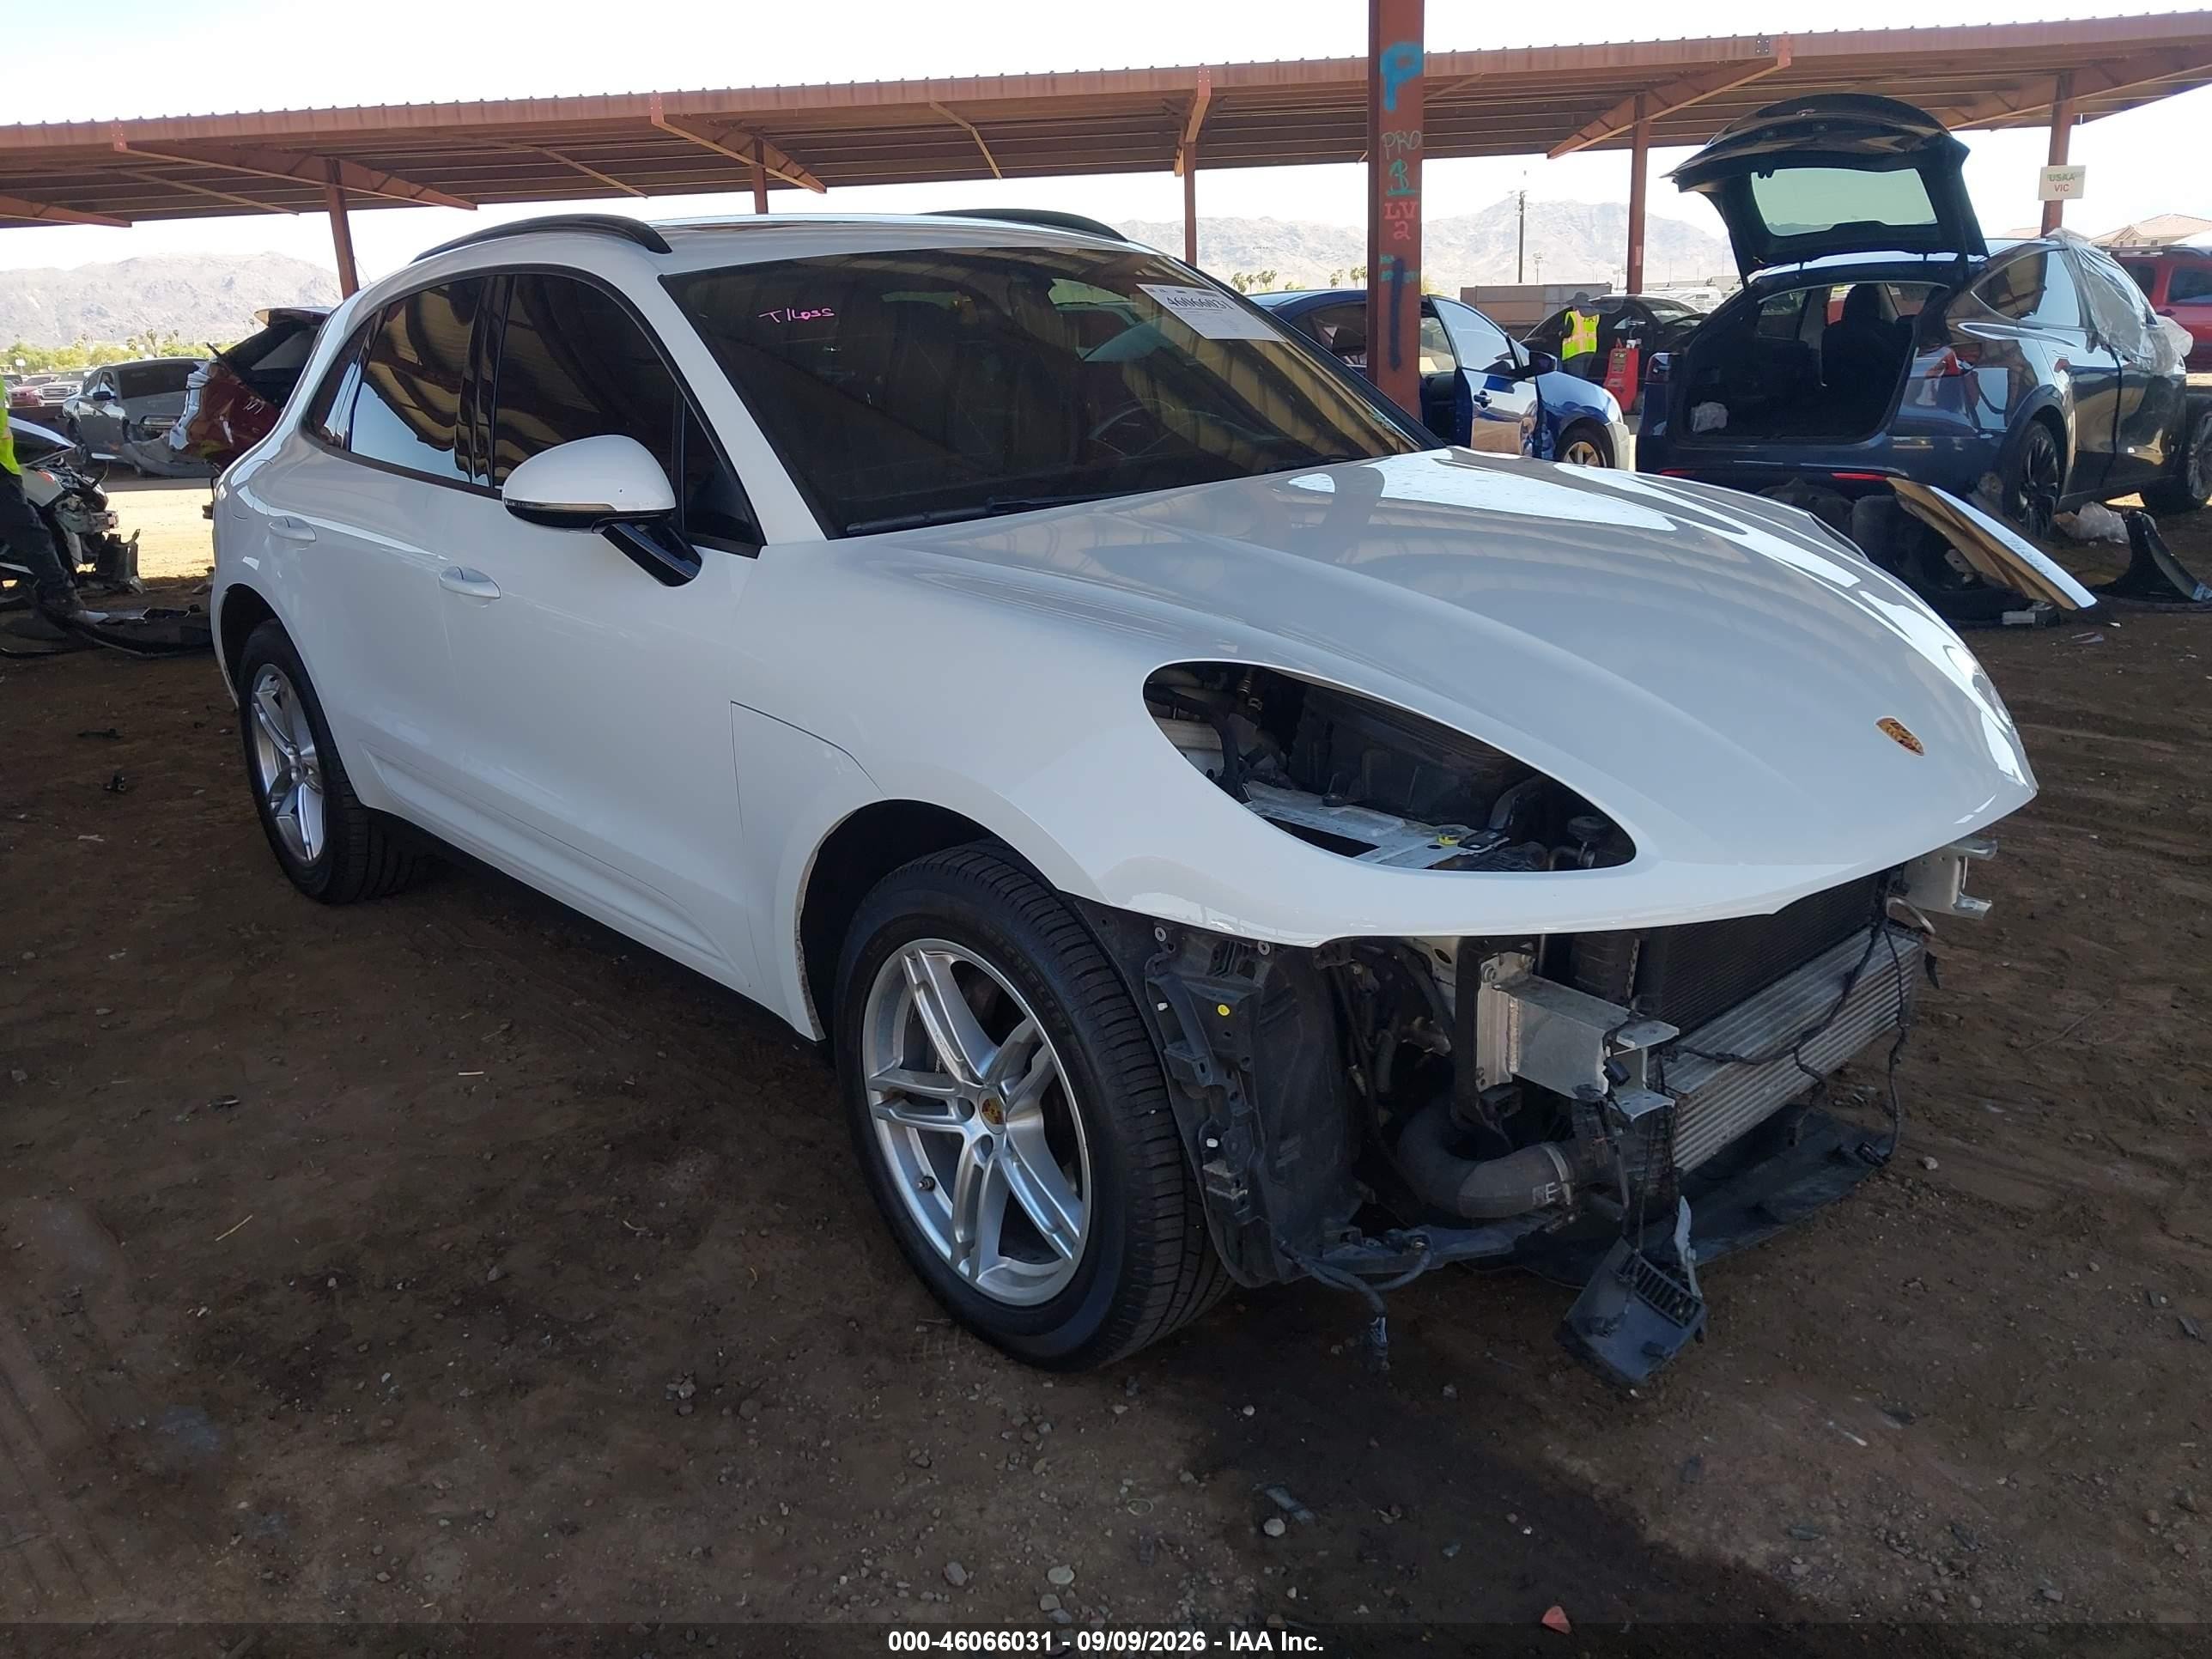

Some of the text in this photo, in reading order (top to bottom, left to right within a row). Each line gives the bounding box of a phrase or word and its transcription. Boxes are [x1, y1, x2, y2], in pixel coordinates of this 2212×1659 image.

[1379, 40, 1423, 112] P
[1382, 130, 1422, 160] PRO
[2053, 184, 2069, 192] VIC
[1384, 200, 1419, 220] LV
[1393, 220, 1411, 240] 2
[1166, 296, 1235, 309] 46066031
